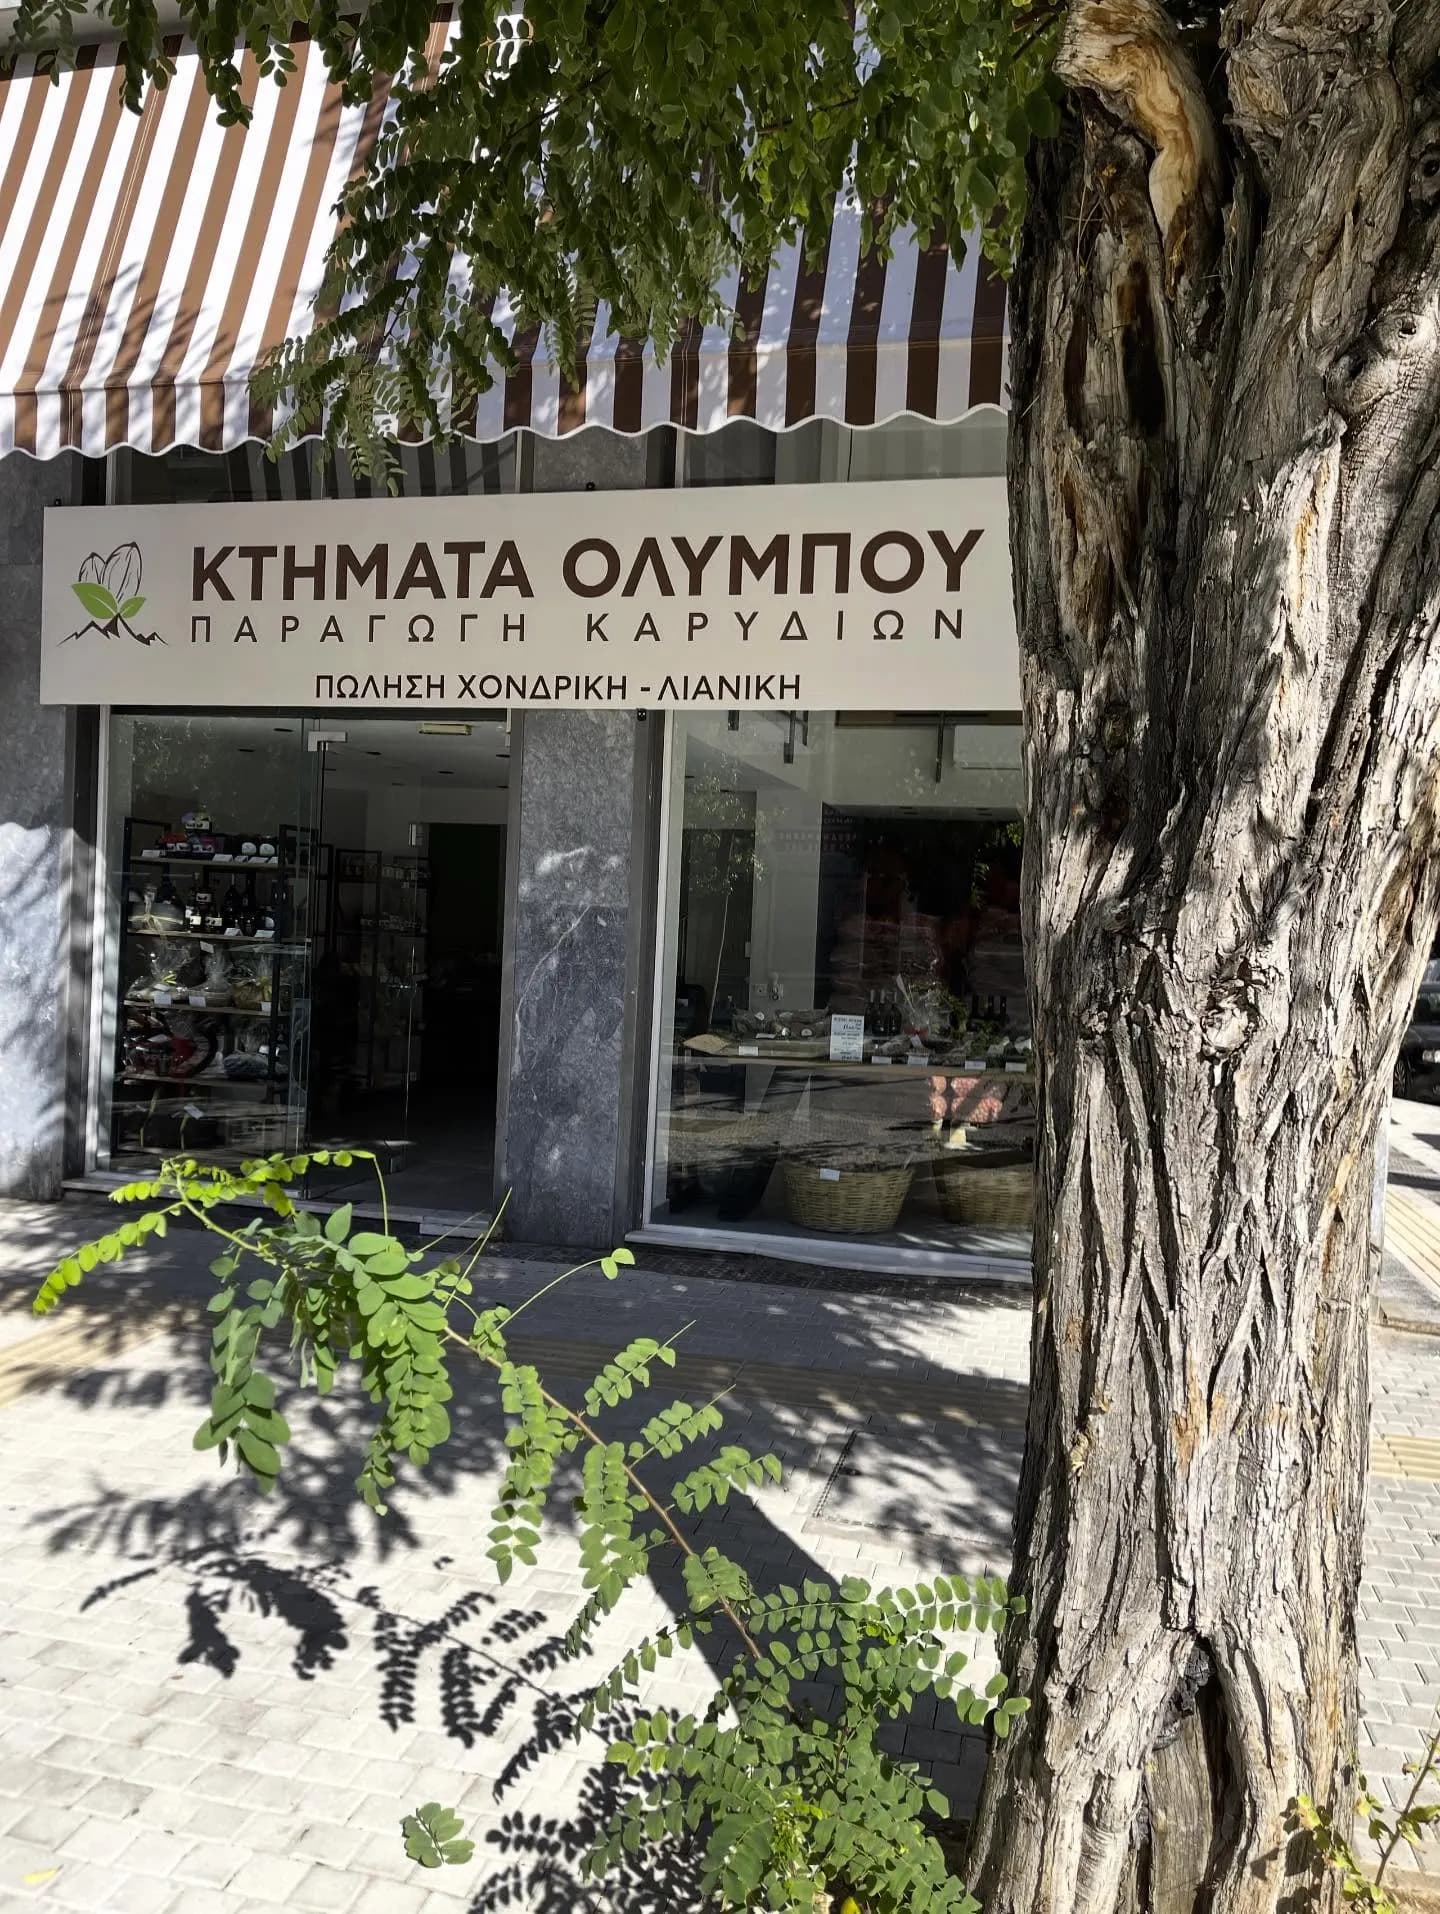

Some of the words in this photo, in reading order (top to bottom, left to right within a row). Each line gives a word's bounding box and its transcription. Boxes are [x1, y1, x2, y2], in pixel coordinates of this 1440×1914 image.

[193, 540, 534, 601] ΚΤΗΜΑΤΑ
[563, 529, 985, 598] ΟΛΥΜΠΟΥ
[191, 614, 525, 643] ΠΑΡΑΓΩΓΗ
[586, 609, 963, 642] ΚΑΡΥΔΙΩΝ
[316, 675, 444, 699] ΠΩΛΗΣΗ
[458, 675, 626, 700] ΧΟΝΔΡΙΚΗ
